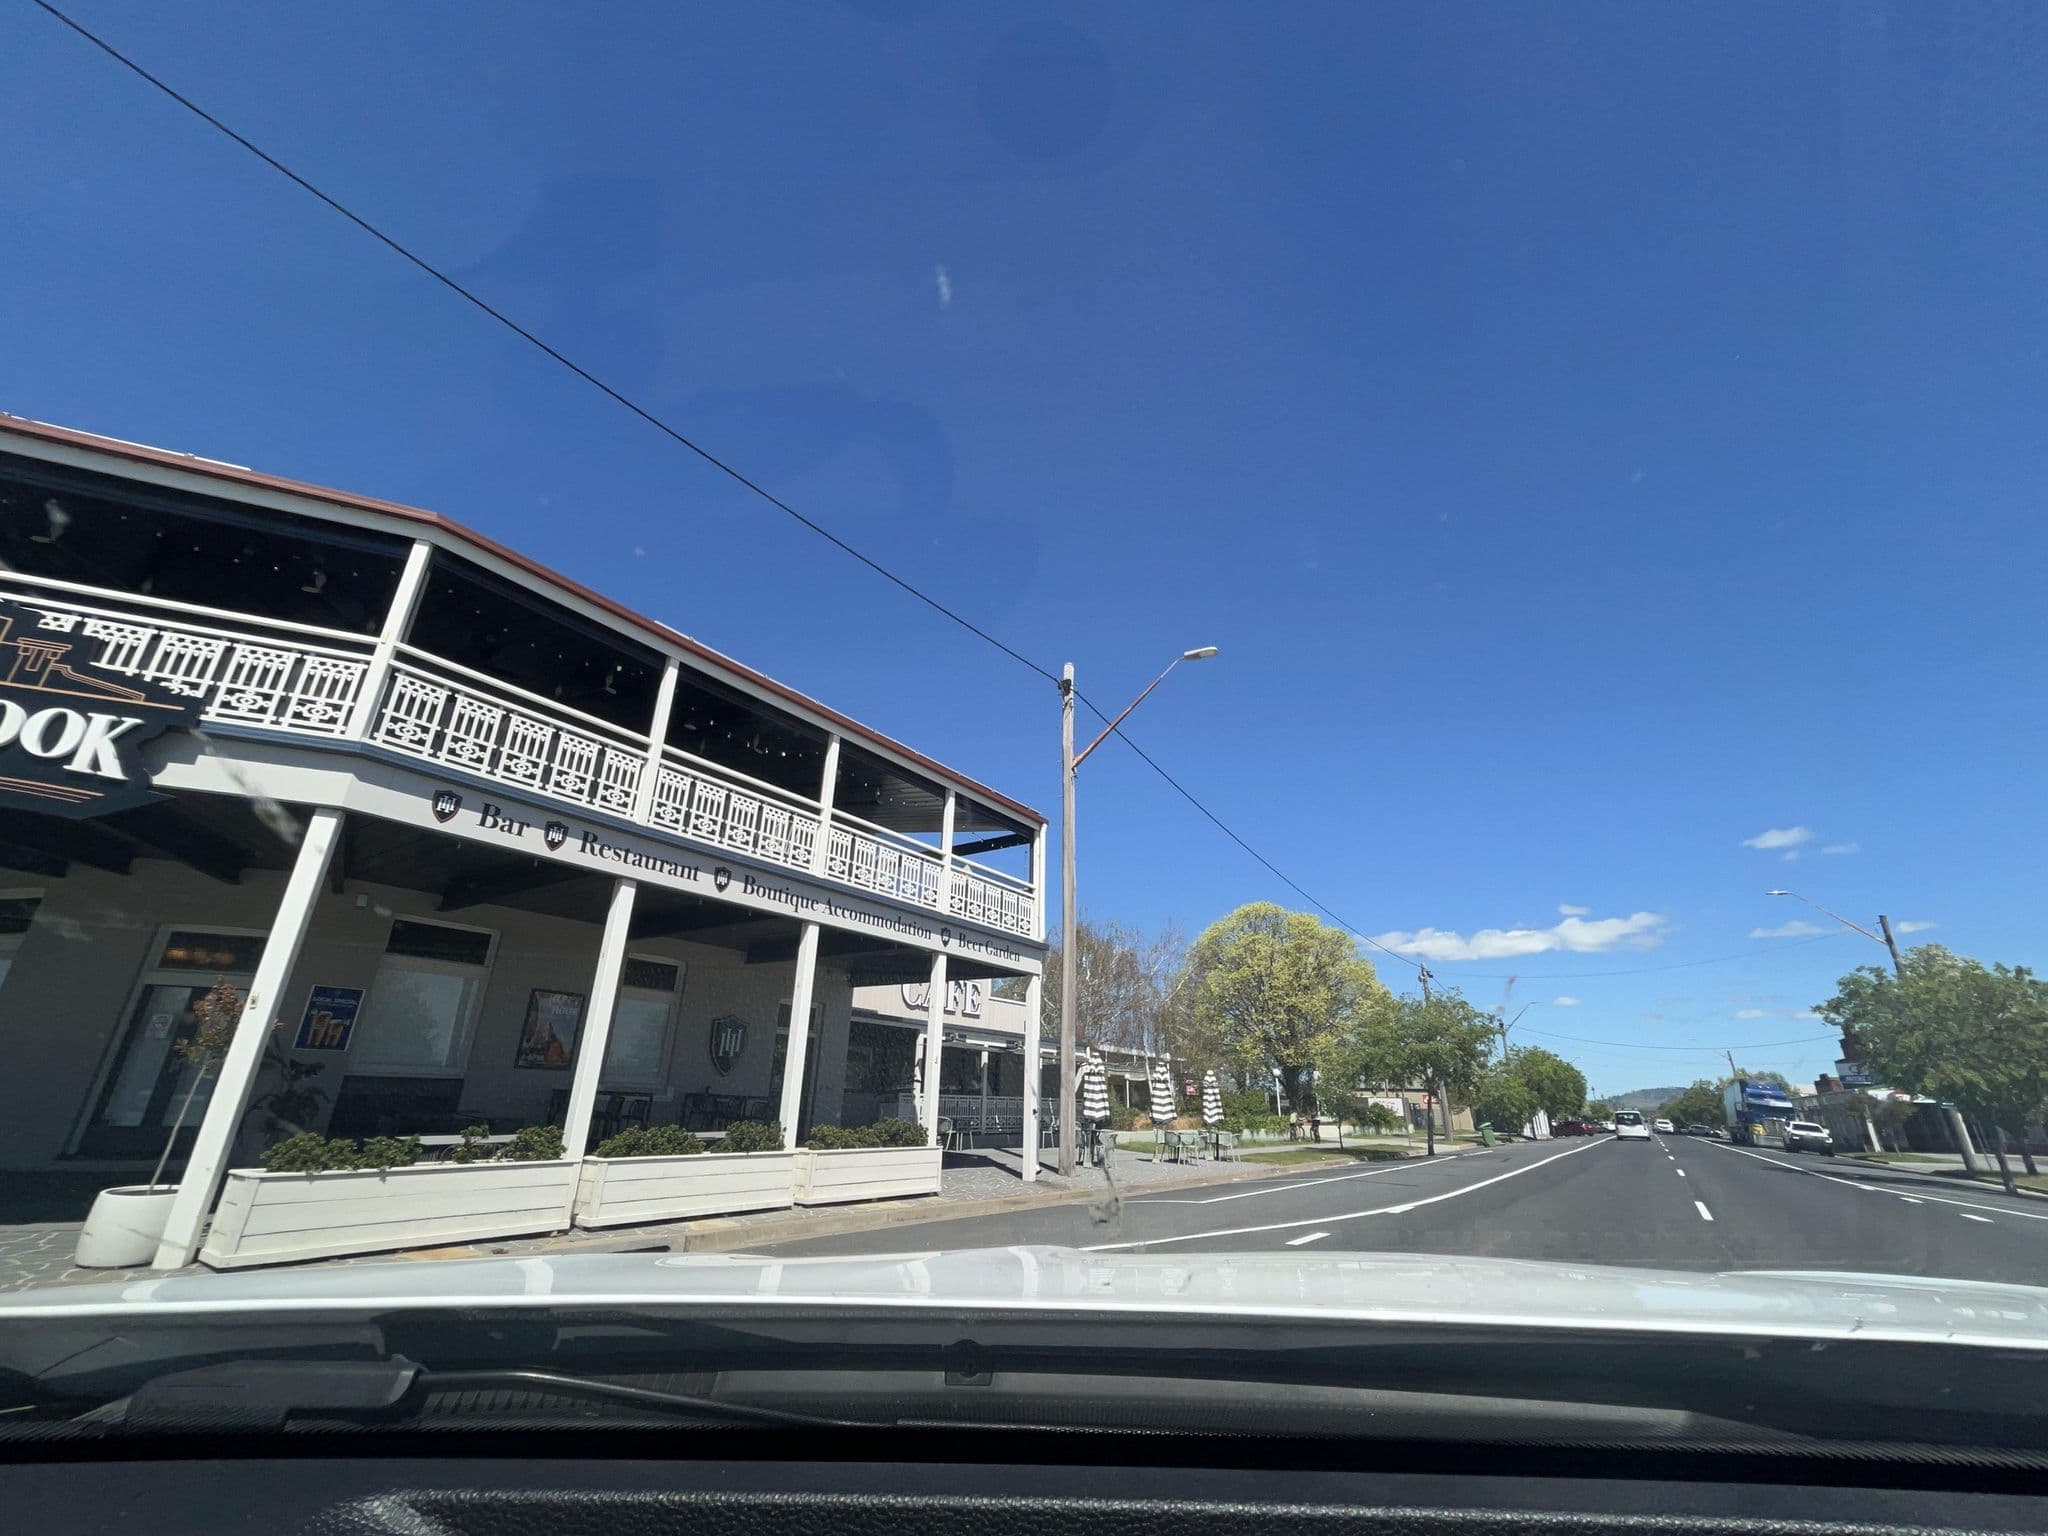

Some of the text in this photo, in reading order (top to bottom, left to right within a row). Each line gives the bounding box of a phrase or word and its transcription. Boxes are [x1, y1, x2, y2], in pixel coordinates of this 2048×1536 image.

[476, 802, 1020, 962] Bar Restaurant Boutique Accommodation Beer Garden
